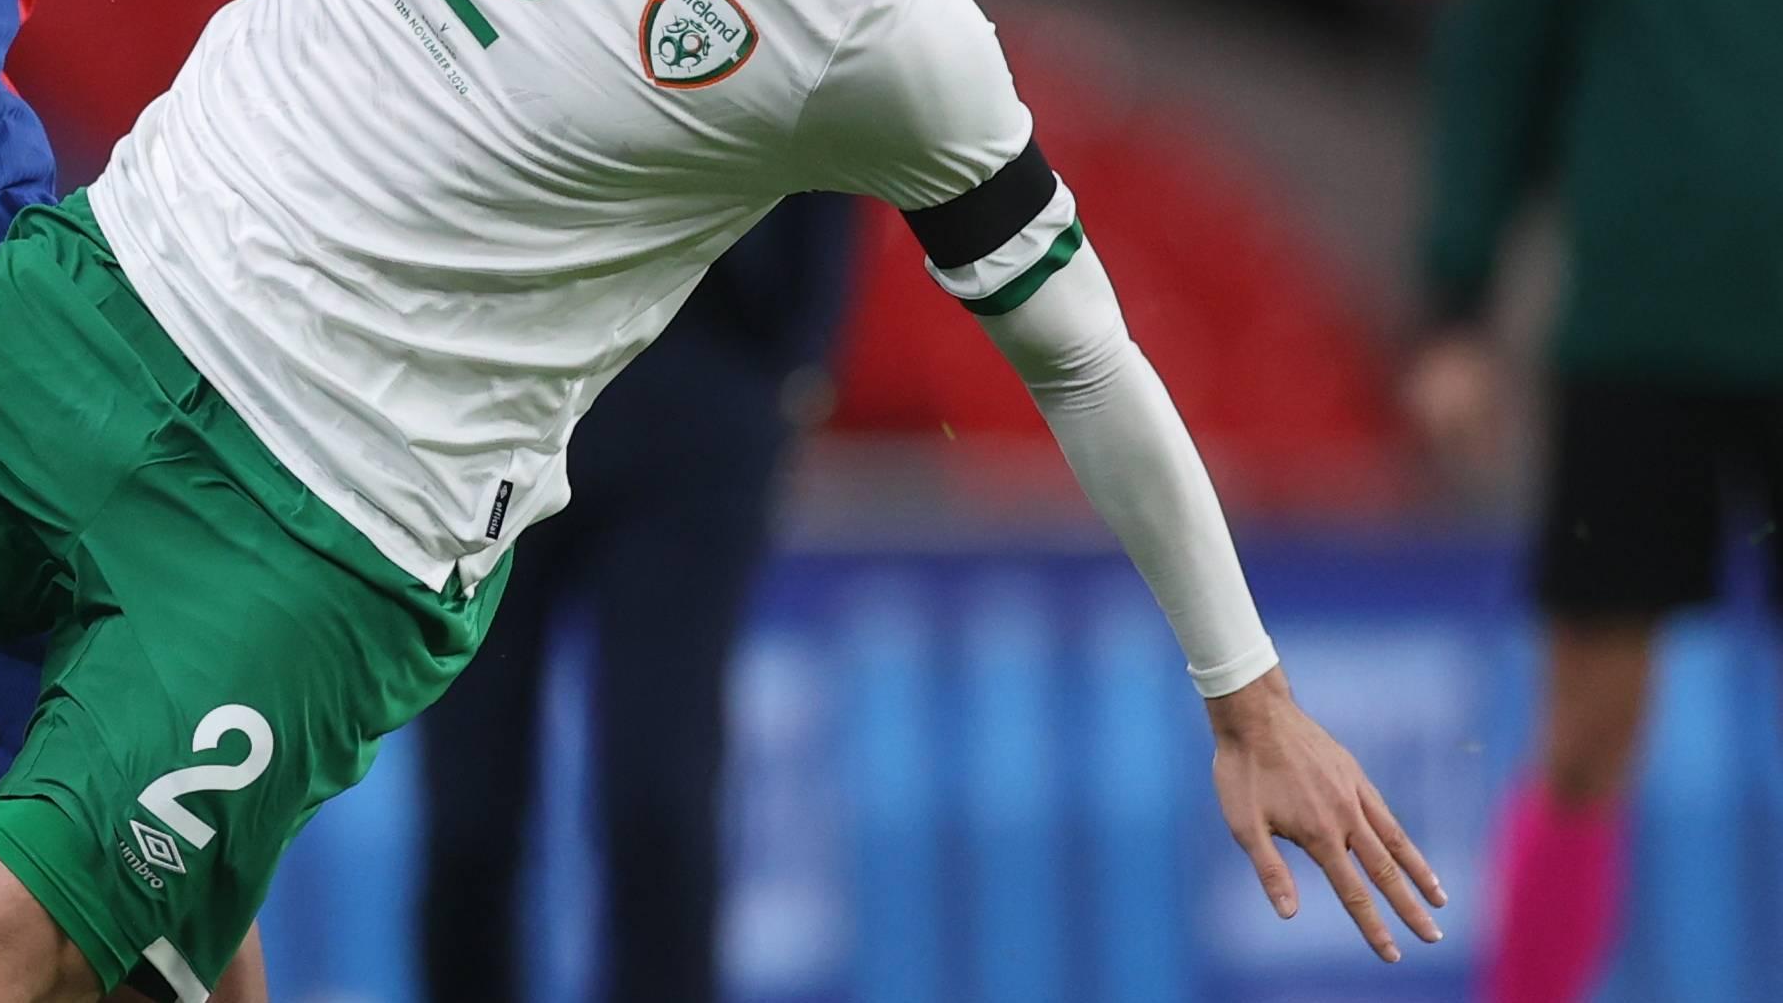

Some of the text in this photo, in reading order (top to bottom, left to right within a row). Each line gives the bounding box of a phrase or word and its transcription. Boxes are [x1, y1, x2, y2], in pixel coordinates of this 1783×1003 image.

[408, 18, 452, 70] NOVEMBER
[447, 70, 469, 95] 2020
[488, 501, 503, 535] official
[136, 703, 274, 850] 2
